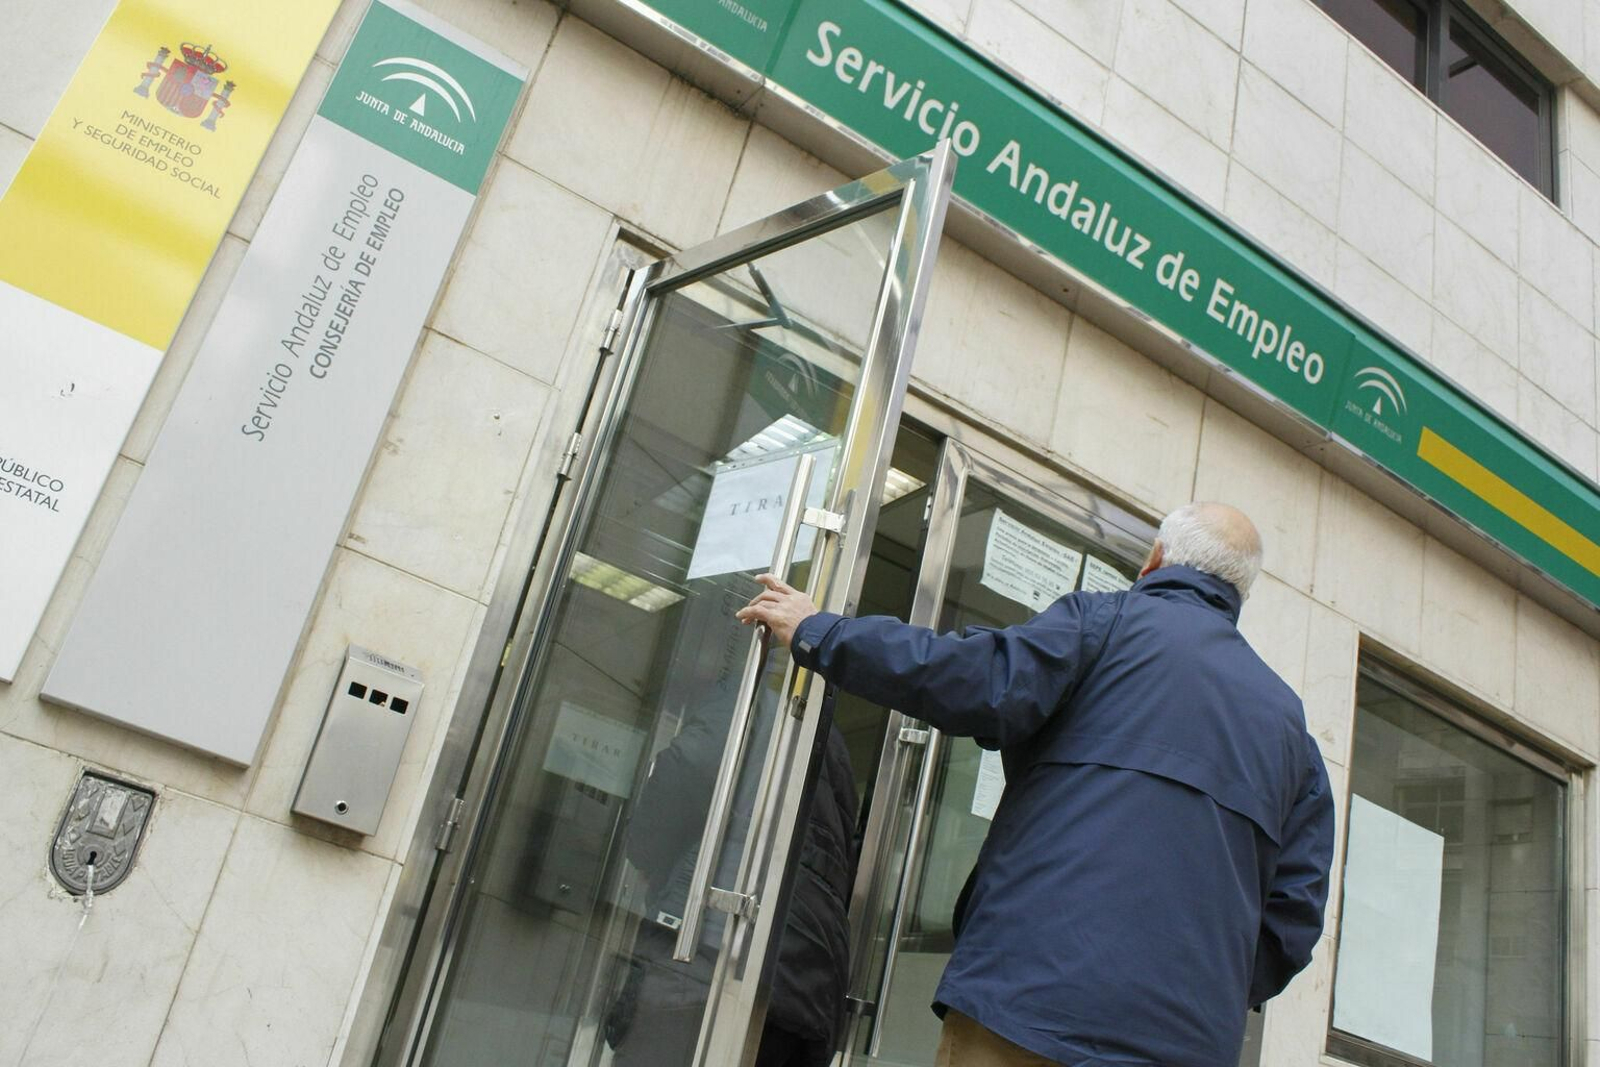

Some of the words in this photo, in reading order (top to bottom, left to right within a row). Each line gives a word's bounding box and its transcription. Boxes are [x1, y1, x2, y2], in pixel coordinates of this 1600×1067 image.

[115, 123, 137, 140] DE
[138, 135, 194, 168] EMPLEO
[121, 109, 202, 156] MINISTERIO
[355, 90, 390, 116] JUNTA
[393, 109, 408, 125] DE
[409, 118, 465, 155] ANDALUCIA
[72, 117, 83, 130] Y
[84, 125, 168, 172] SEGURIDAD
[170, 167, 221, 199] SOCIAL
[332, 173, 379, 242] Empleo
[806, 20, 980, 157] Servicio
[986, 139, 1151, 270] Andaluz
[1155, 251, 1200, 302] de
[1205, 277, 1325, 385] Empleo
[309, 279, 366, 379] CONSEJERÍA
[354, 251, 377, 277] DE
[366, 187, 405, 251] EMPLEO
[321, 245, 346, 272] de
[281, 275, 333, 358] Andaluz
[241, 363, 293, 442] Servicio
[0, 456, 64, 492] ÚBLICO
[730, 494, 783, 516] TIRA
